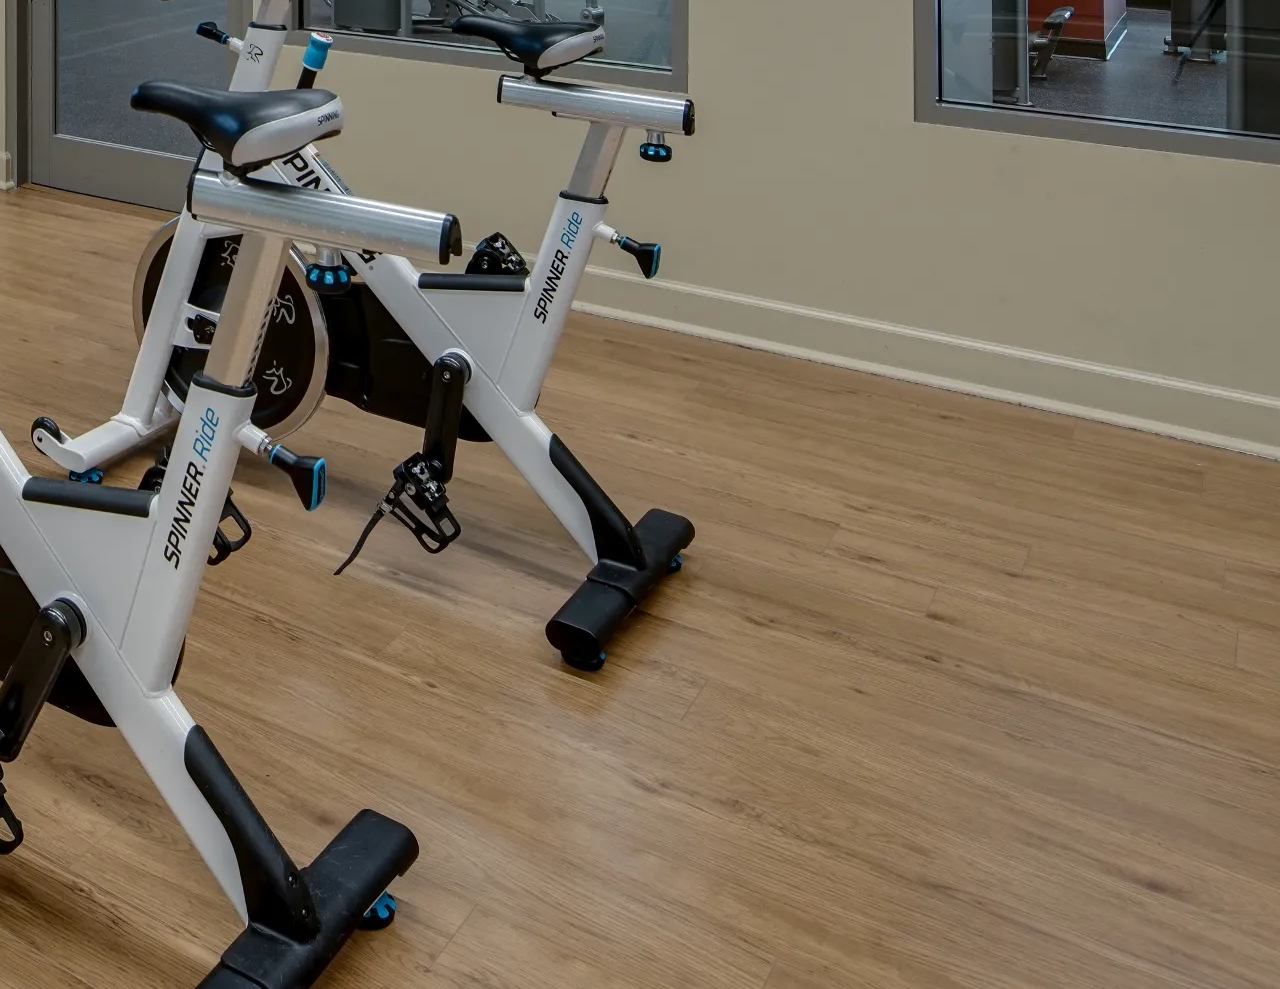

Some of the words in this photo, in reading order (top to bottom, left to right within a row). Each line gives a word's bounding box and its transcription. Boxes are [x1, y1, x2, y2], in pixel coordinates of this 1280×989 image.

[317, 109, 340, 127] SPINNING
[533, 249, 569, 324] SPINNER
[560, 211, 583, 250] Ride
[163, 461, 204, 570] SPINNER
[192, 407, 220, 462] Ride
